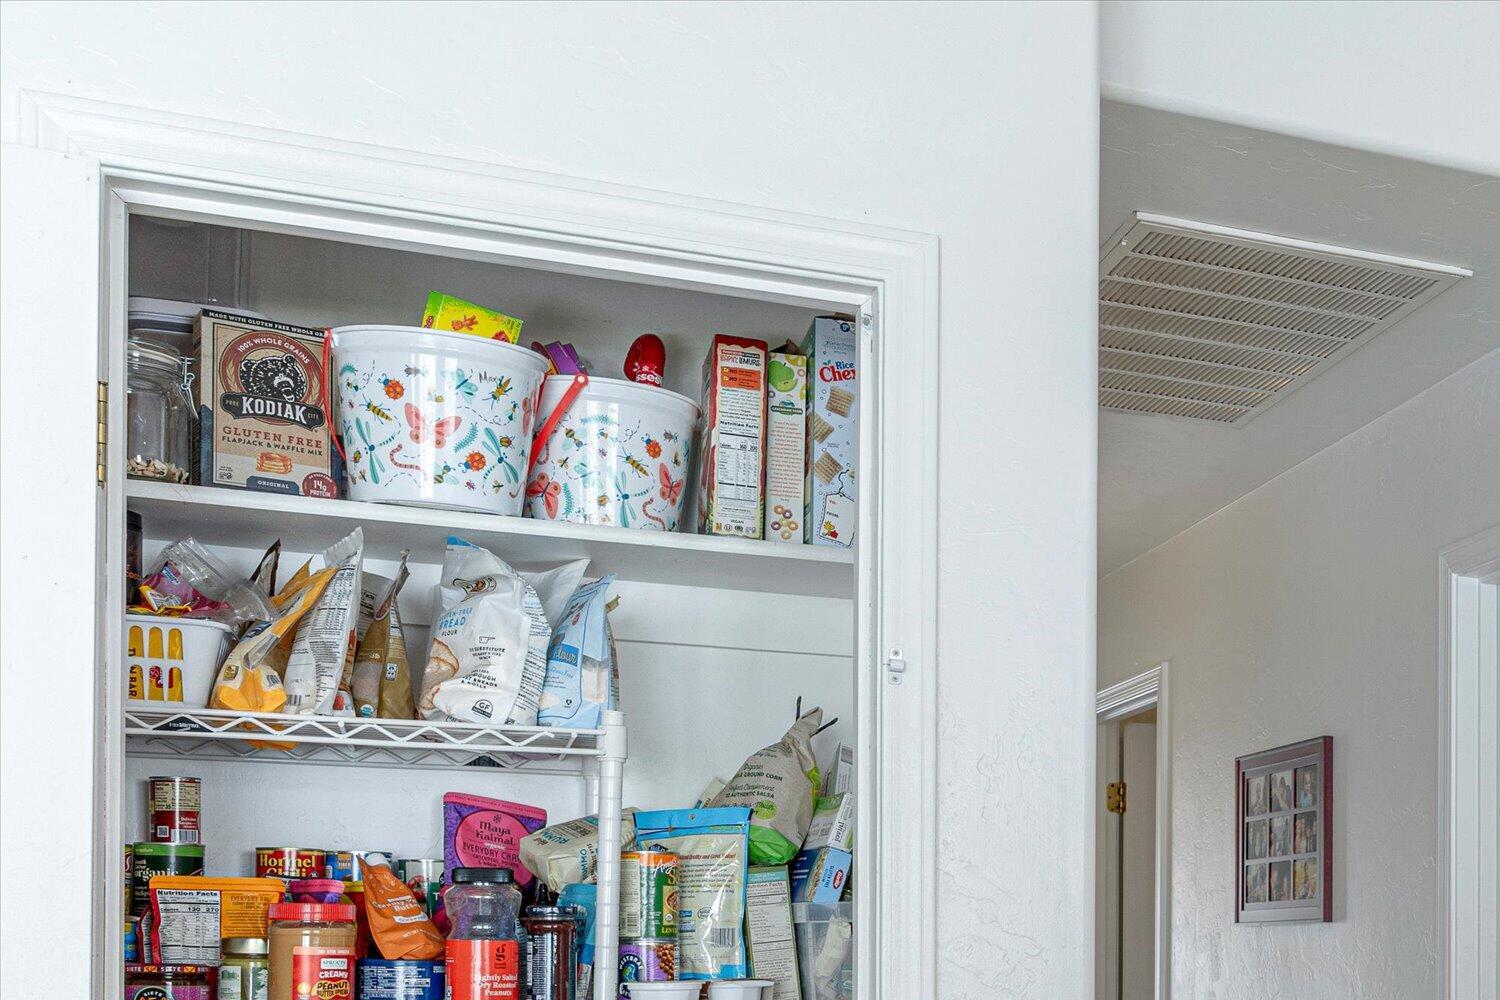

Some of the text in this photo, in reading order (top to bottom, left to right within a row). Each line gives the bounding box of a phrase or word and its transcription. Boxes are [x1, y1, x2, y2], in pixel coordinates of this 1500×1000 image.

[209, 311, 314, 335] MADE WITH GLUTEN FREE WHOLE
[237, 337, 310, 364] 100% WHOLE GRAINS
[835, 361, 854, 370] Rice
[241, 396, 307, 424] KODIAK
[222, 426, 322, 449] GLUTEN FREE
[222, 436, 263, 447] FLAPJACK
[273, 443, 305, 453] WAFFLE
[257, 480, 290, 489] ORIGINAL
[765, 773, 783, 781] CORN
[756, 791, 775, 799] SALSA
[479, 821, 511, 835] Maya
[476, 830, 514, 845] Kaimal
[463, 841, 498, 858] EVERYDAY
[319, 971, 348, 979] CREAMY
[317, 981, 349, 990] PEANUT
